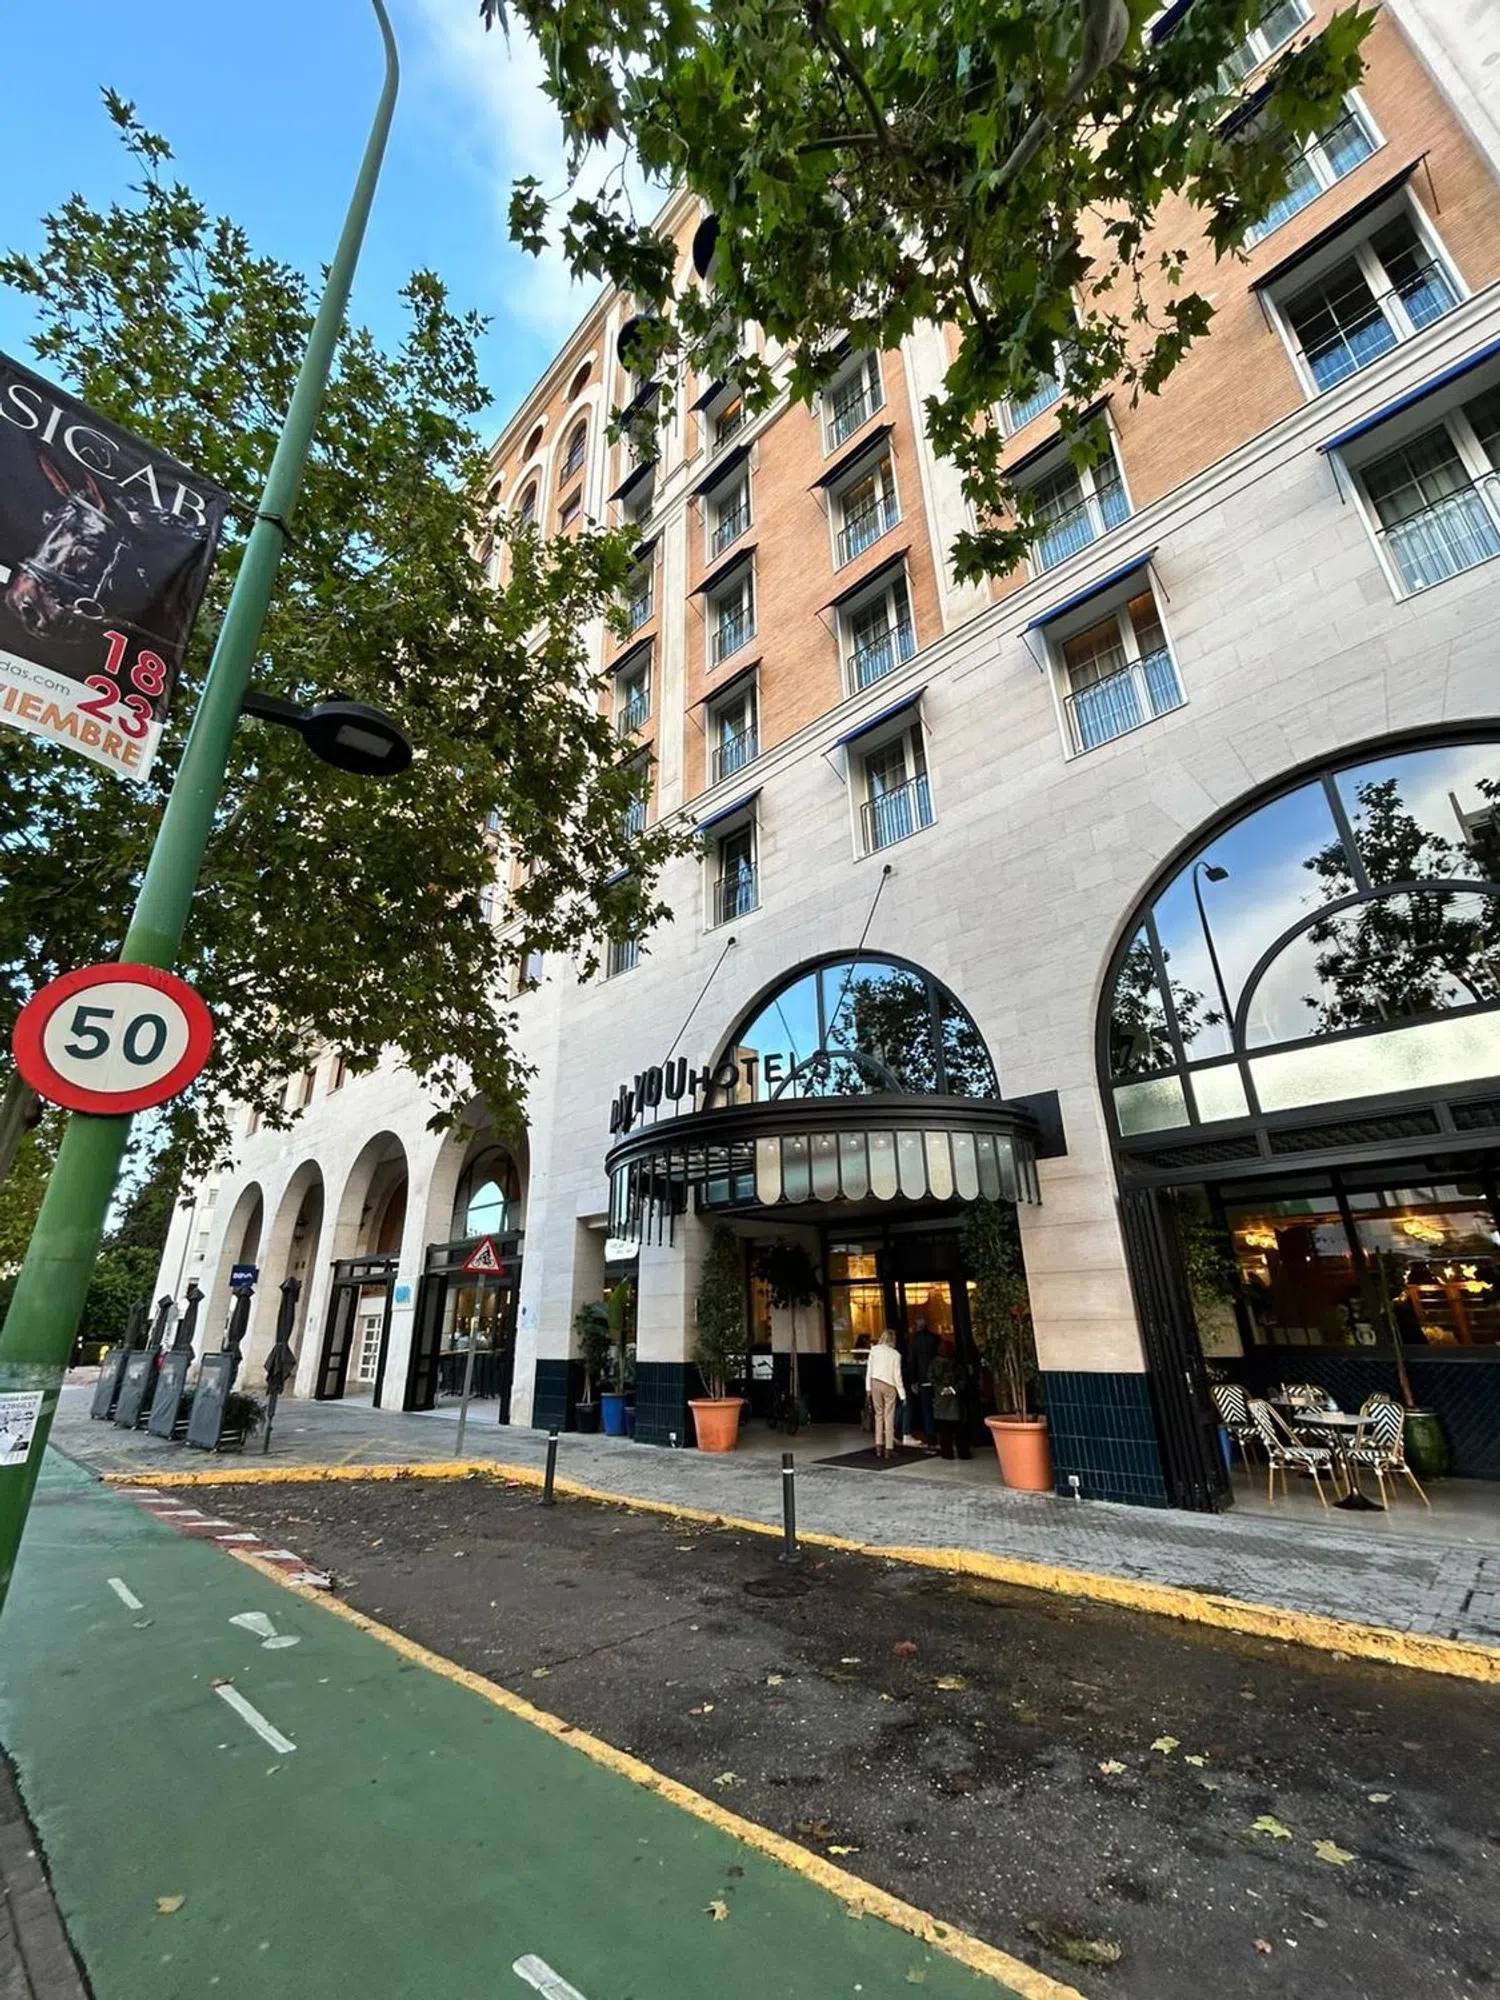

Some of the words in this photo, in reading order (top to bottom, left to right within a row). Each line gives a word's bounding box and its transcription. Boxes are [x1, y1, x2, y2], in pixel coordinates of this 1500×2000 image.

[0, 384, 207, 527] SICAB
[103, 630, 167, 696] 18
[77, 675, 153, 739] 23
[64, 1005, 168, 1066] 50
